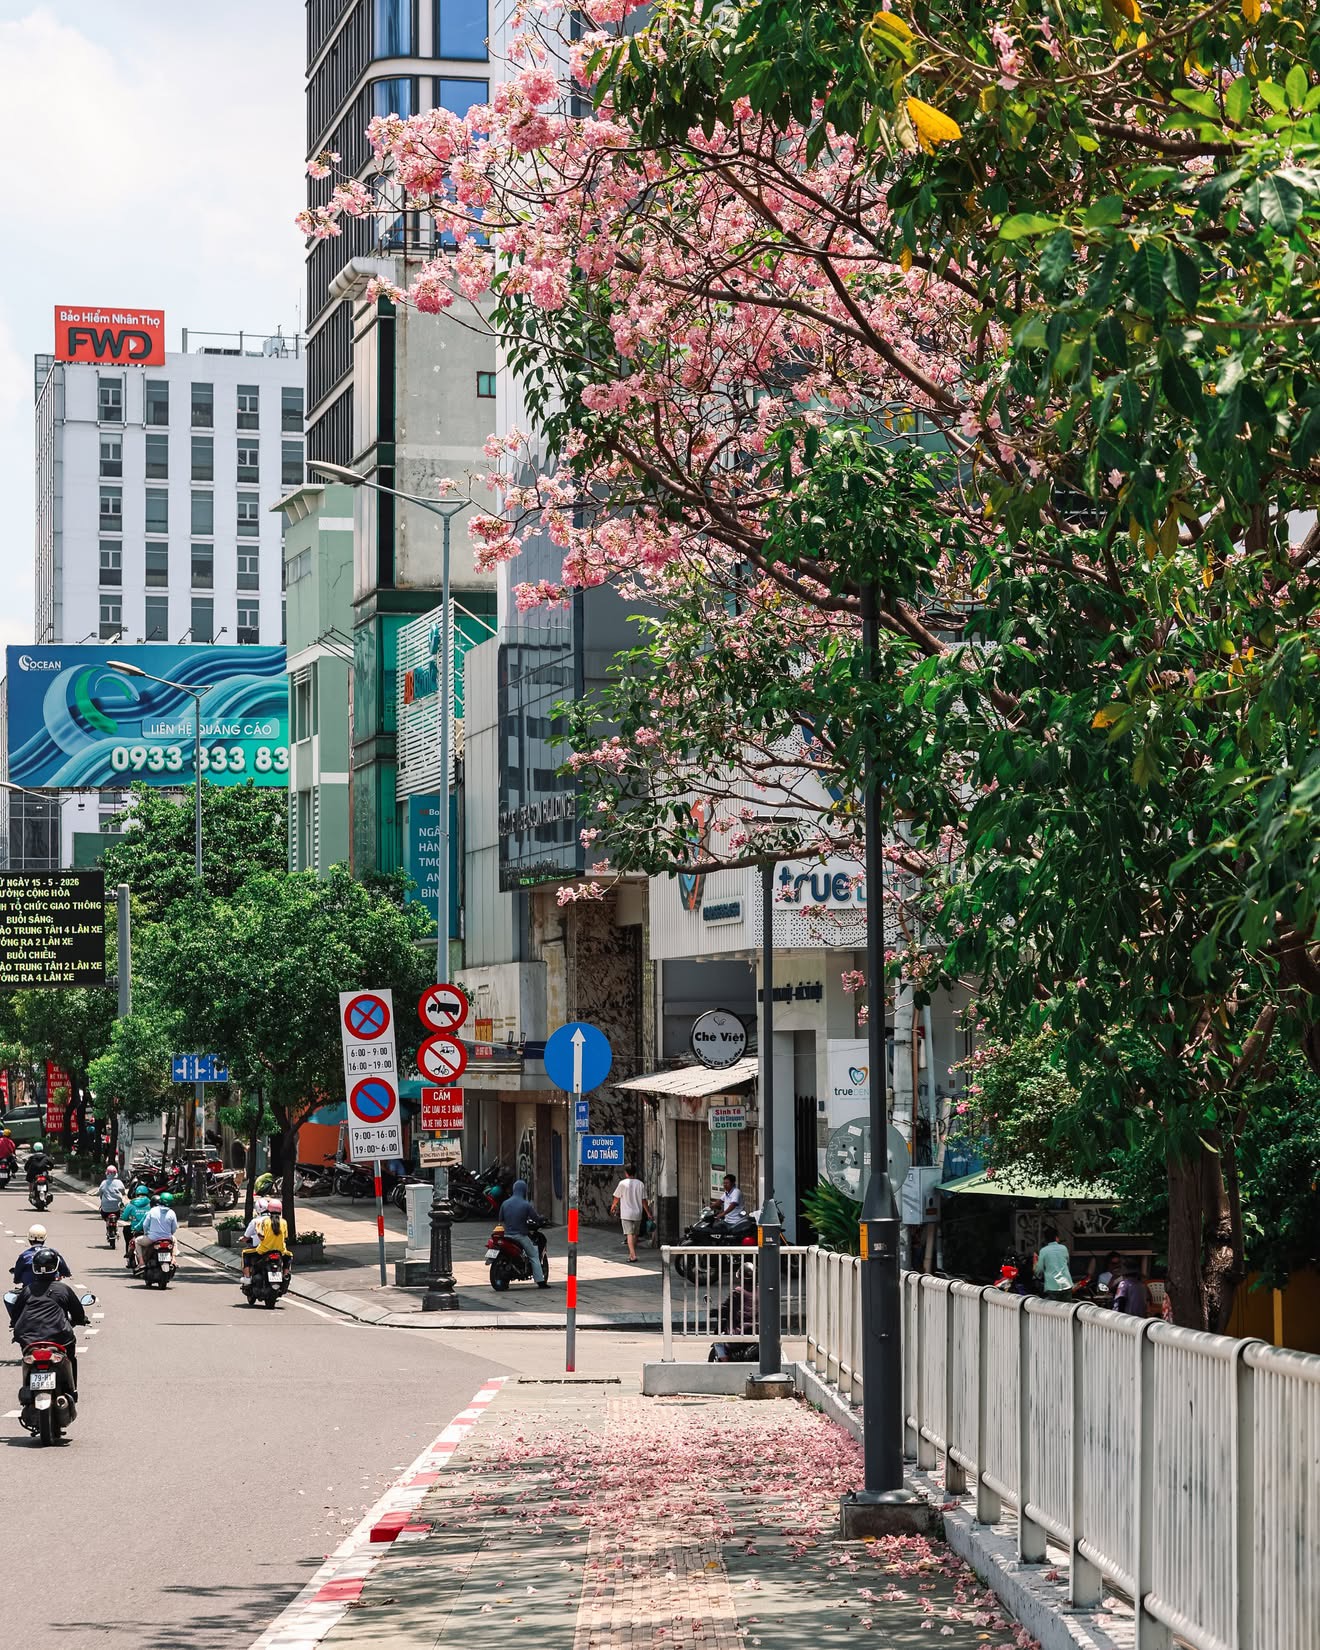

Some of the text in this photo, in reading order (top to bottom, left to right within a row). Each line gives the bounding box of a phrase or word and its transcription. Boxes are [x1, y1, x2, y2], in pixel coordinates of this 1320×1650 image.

[61, 309, 160, 328] Bảo Hiểm Nhân Thọ
[68, 327, 152, 359] FWD
[151, 721, 272, 737] LIÊN HỆ QUẢNG CÁO
[111, 746, 183, 773] 0933
[256, 746, 288, 773] 83
[7, 876, 29, 886] NGÀY
[779, 865, 866, 902] true
[26, 888, 49, 898] CỘNG
[51, 887, 70, 897] HÒA
[10, 898, 21, 911] TỔ
[24, 900, 48, 910] CHỨC
[50, 902, 70, 910] GIAO
[73, 900, 101, 910] THÔNG
[6, 910, 53, 923] BUỔI SÁNG:
[14, 926, 42, 934] TRUNG
[44, 924, 62, 934] TÂM
[64, 926, 69, 934] 4
[72, 924, 89, 934] LÀN
[91, 926, 102, 934] XE
[20, 938, 34, 946] RA
[36, 938, 40, 946] 2
[42, 936, 60, 946] LÀN
[6, 946, 56, 959] BUỔI CHIỀU:
[44, 961, 62, 970] TÂM
[72, 960, 89, 970] LÀN
[91, 962, 102, 970] XE
[0, 972, 19, 982] ỚNG
[21, 974, 34, 982] RA
[44, 972, 61, 981] LÀN
[63, 973, 74, 981] XE
[695, 1032, 744, 1044] Chè Việt
[351, 1049, 365, 1057] 6:00
[349, 1062, 367, 1071] 16:00
[374, 1060, 391, 1069] 19:00
[434, 1088, 450, 1100] CẤM
[441, 1105, 446, 1114] XE
[354, 1132, 370, 1140] 9:00
[377, 1130, 396, 1138] 16:00
[592, 1137, 614, 1146] ĐƯỜNG
[355, 1145, 375, 1154] 19:00
[381, 1144, 397, 1152] 6:00
[587, 1146, 618, 1159] CAO THẮNG
